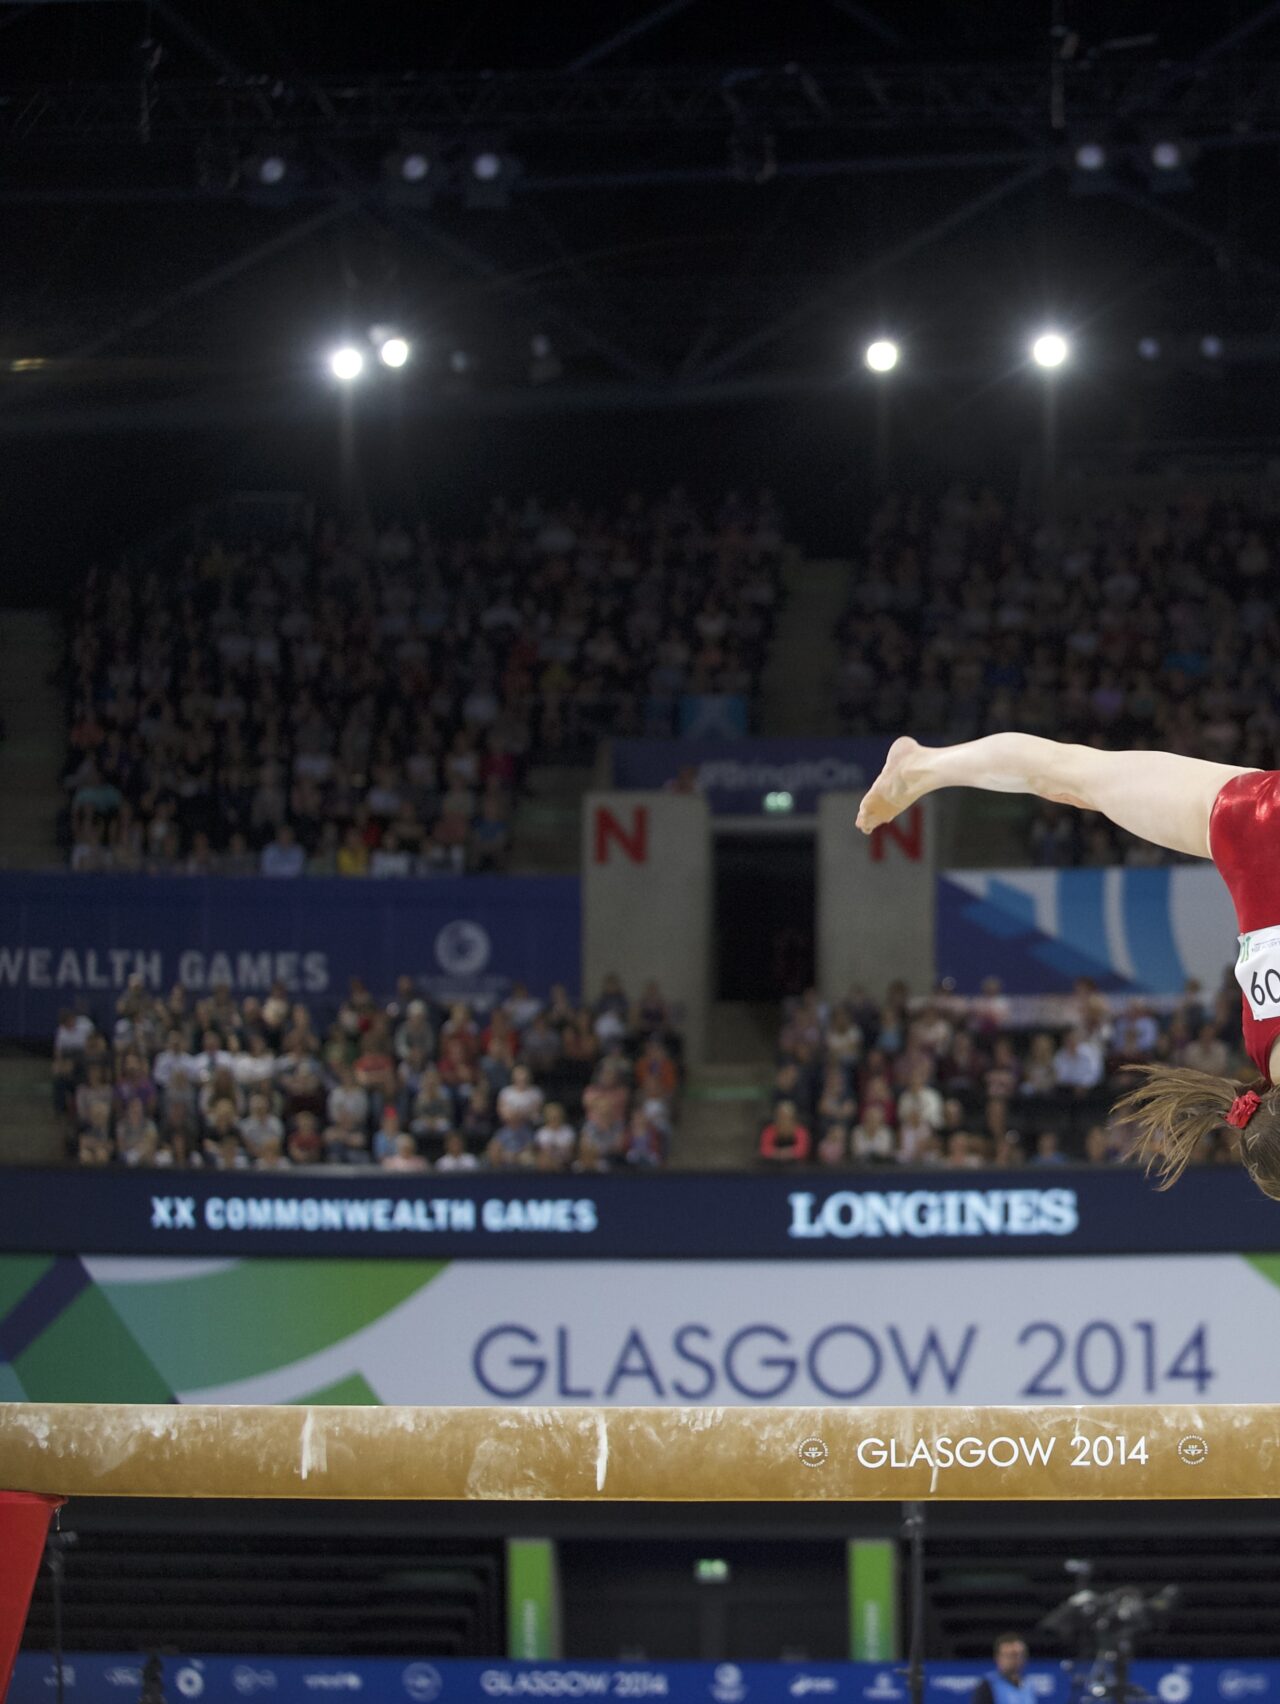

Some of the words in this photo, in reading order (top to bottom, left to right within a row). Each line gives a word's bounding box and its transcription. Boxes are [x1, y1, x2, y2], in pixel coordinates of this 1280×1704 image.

[593, 804, 648, 865] N
[179, 951, 328, 992] GAMES
[151, 1197, 195, 1230] XX
[204, 1199, 475, 1231] COMMONWEALTH
[482, 1199, 598, 1232] GAMES
[787, 1188, 1079, 1238] LONGINES
[472, 1323, 978, 1400] GLASGOW
[1017, 1320, 1215, 1399] 2014
[857, 1436, 1056, 1468] GLASGOW
[1069, 1434, 1149, 1466] 2014
